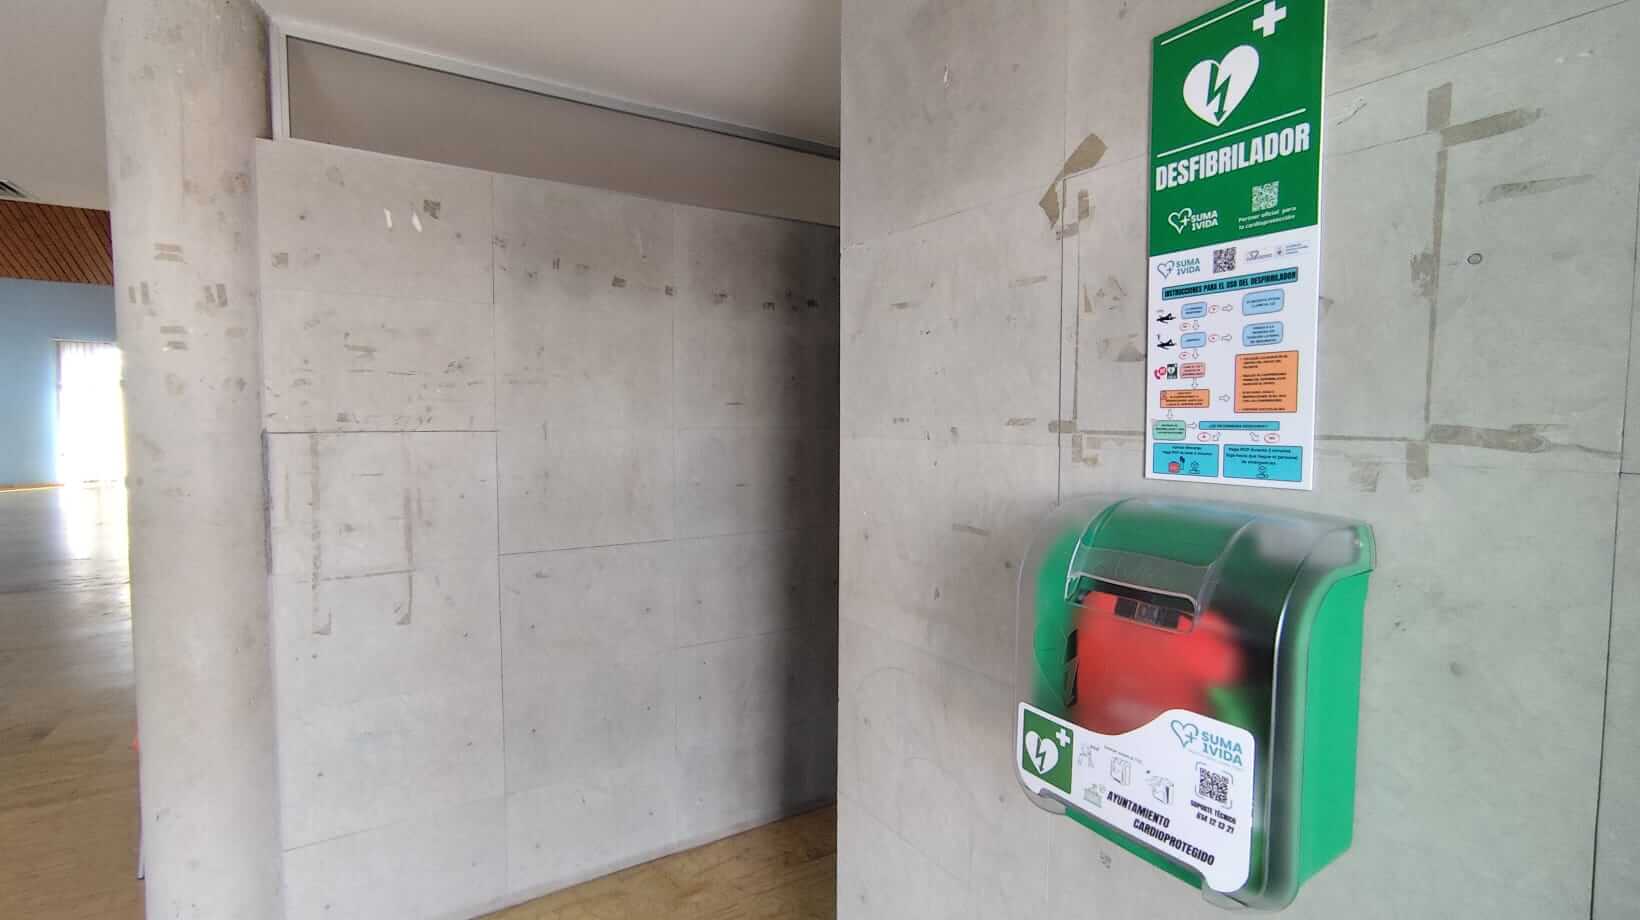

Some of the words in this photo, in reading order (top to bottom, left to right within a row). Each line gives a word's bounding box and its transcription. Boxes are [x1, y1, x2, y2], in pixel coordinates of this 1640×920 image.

[1155, 122, 1310, 191] DESFIBRILADOR
[1190, 210, 1218, 223] SUMA
[1175, 257, 1201, 268] SUMA
[1164, 284, 1202, 298] INSTRUCCIONES
[1203, 283, 1218, 292] PARA
[1218, 282, 1225, 290] EL
[1226, 280, 1238, 289] USO
[1238, 279, 1249, 287] DEL
[1250, 271, 1297, 285] DESFIBRILADOR
[1201, 730, 1242, 754] SUMA
[1202, 742, 1243, 767] 1VIDA
[1106, 790, 1170, 829] AYUNTAMIENTO
[1214, 808, 1236, 825] TÉCNICO
[1133, 818, 1215, 867] CARDIOPROTEGIDO
